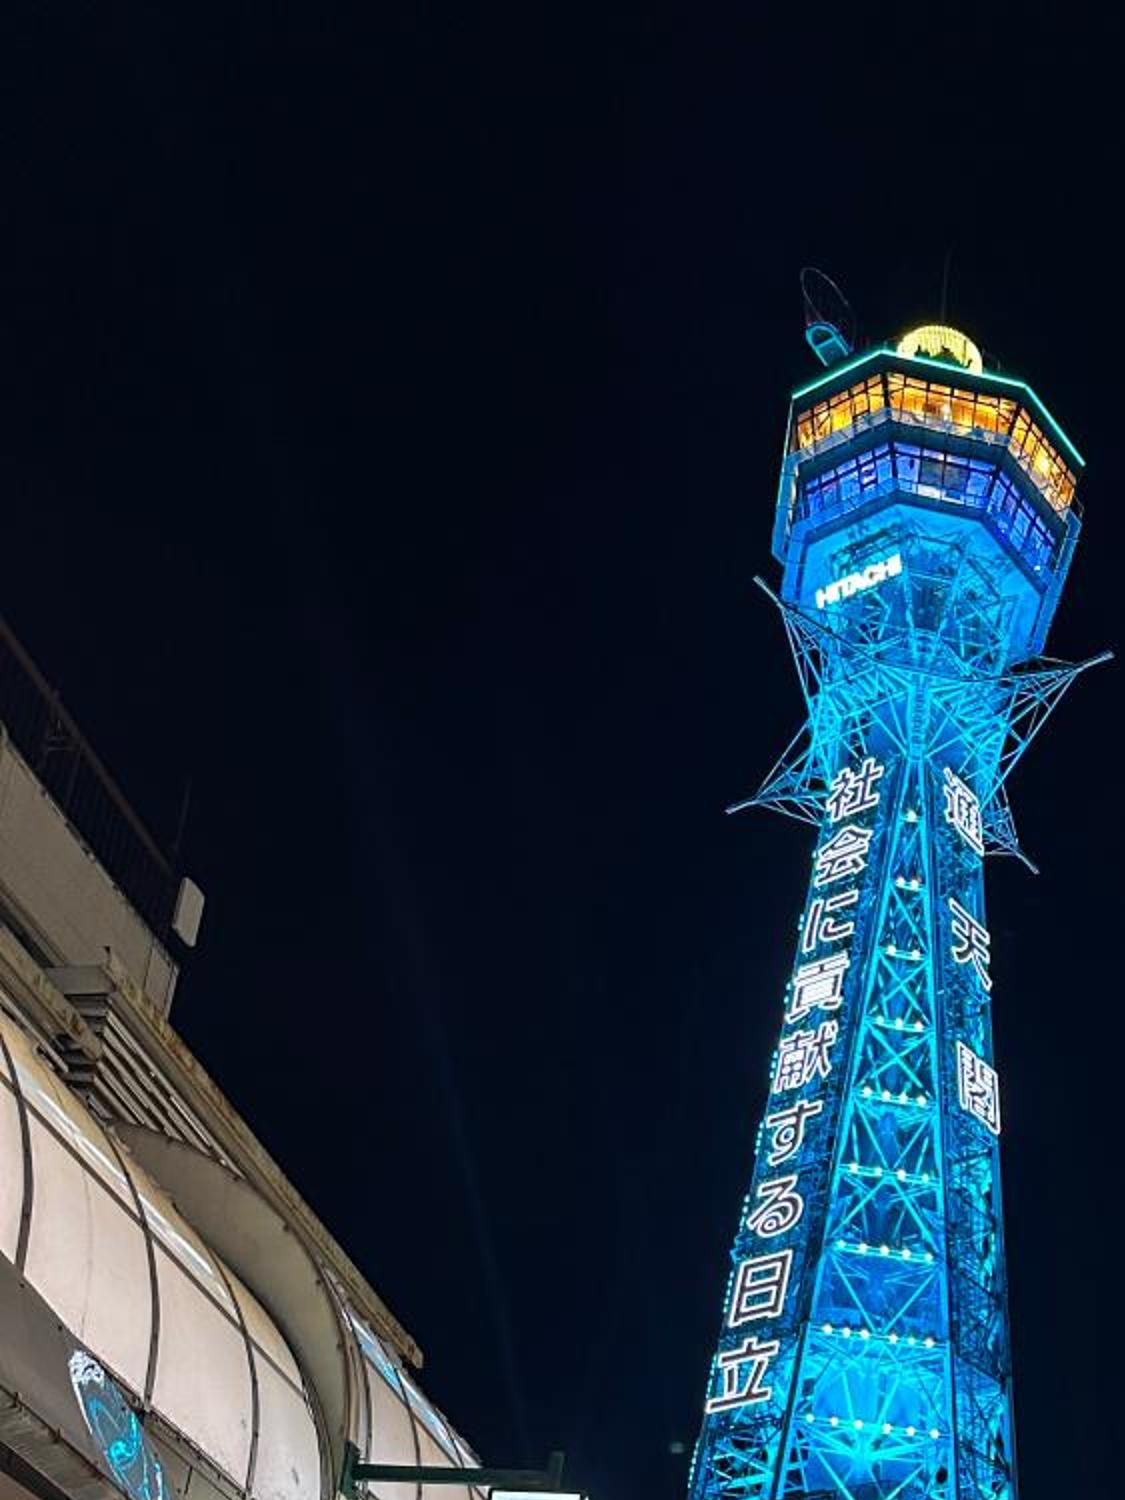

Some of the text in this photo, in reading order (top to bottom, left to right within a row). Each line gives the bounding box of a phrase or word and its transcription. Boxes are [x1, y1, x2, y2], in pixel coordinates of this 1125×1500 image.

[815, 553, 902, 609] HITACHI
[706, 756, 886, 1415] 社会に貢献する日立
[942, 766, 1001, 1136] 通天閣
